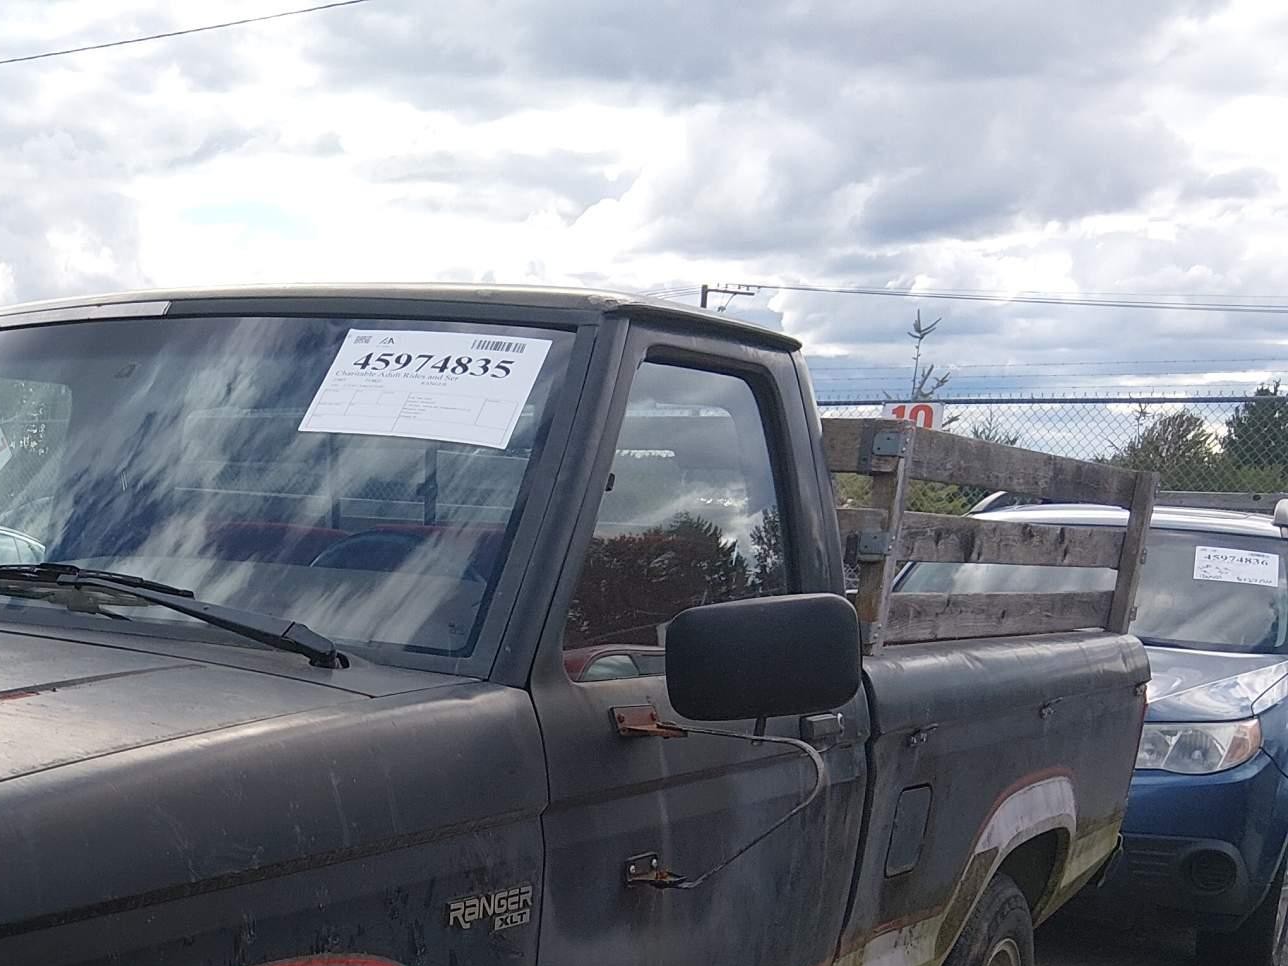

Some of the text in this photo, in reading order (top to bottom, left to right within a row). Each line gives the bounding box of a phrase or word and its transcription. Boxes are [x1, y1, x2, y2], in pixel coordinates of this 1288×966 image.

[353, 352, 515, 379] 45974835
[449, 885, 532, 929] RANGER
[497, 910, 528, 928] XLT
